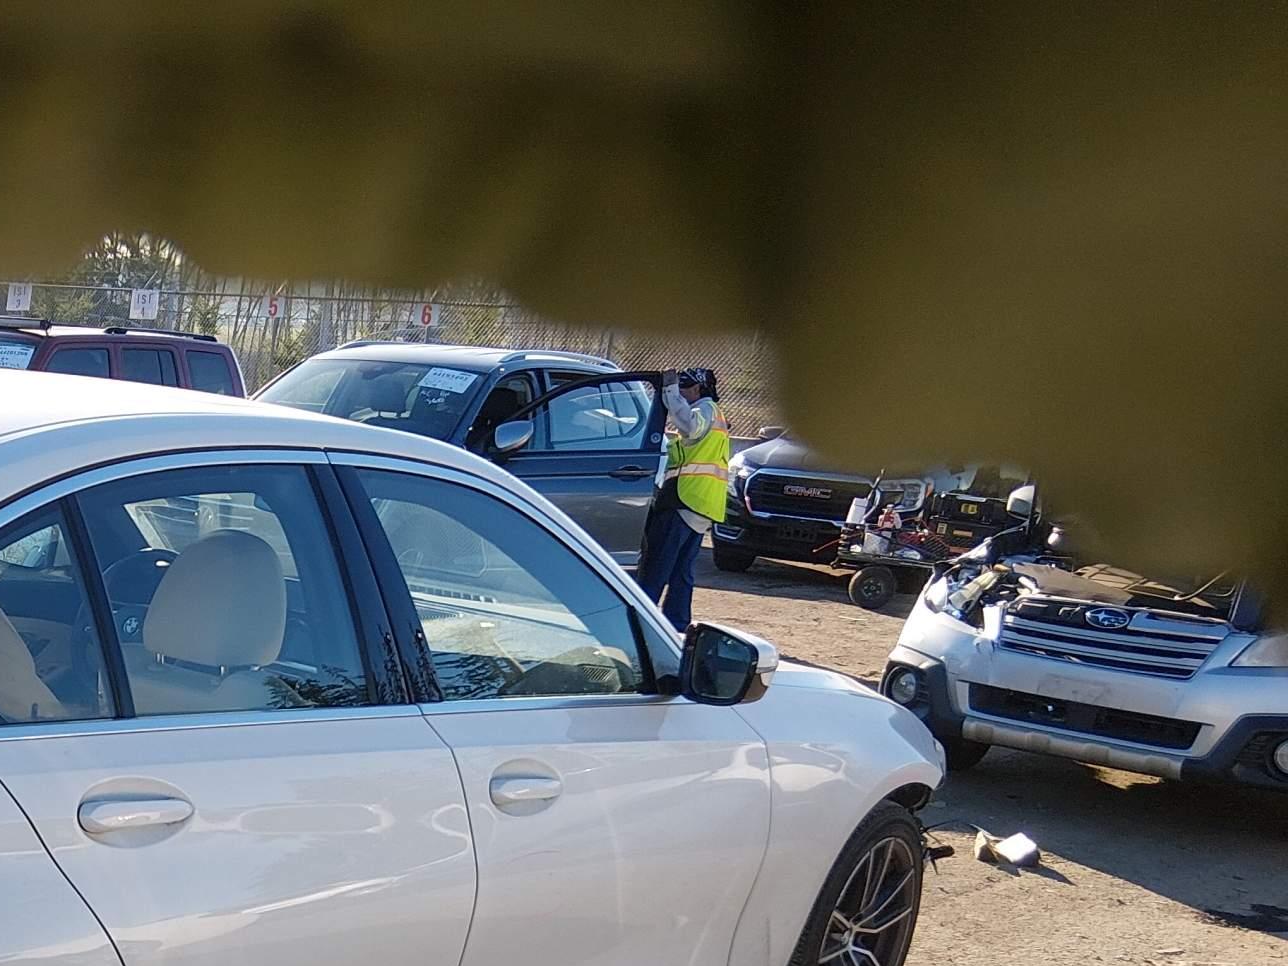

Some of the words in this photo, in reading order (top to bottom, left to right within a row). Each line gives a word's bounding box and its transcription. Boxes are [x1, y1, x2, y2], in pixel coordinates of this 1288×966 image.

[268, 297, 278, 317] 5
[421, 304, 432, 325] 6
[783, 485, 833, 499] GMC
